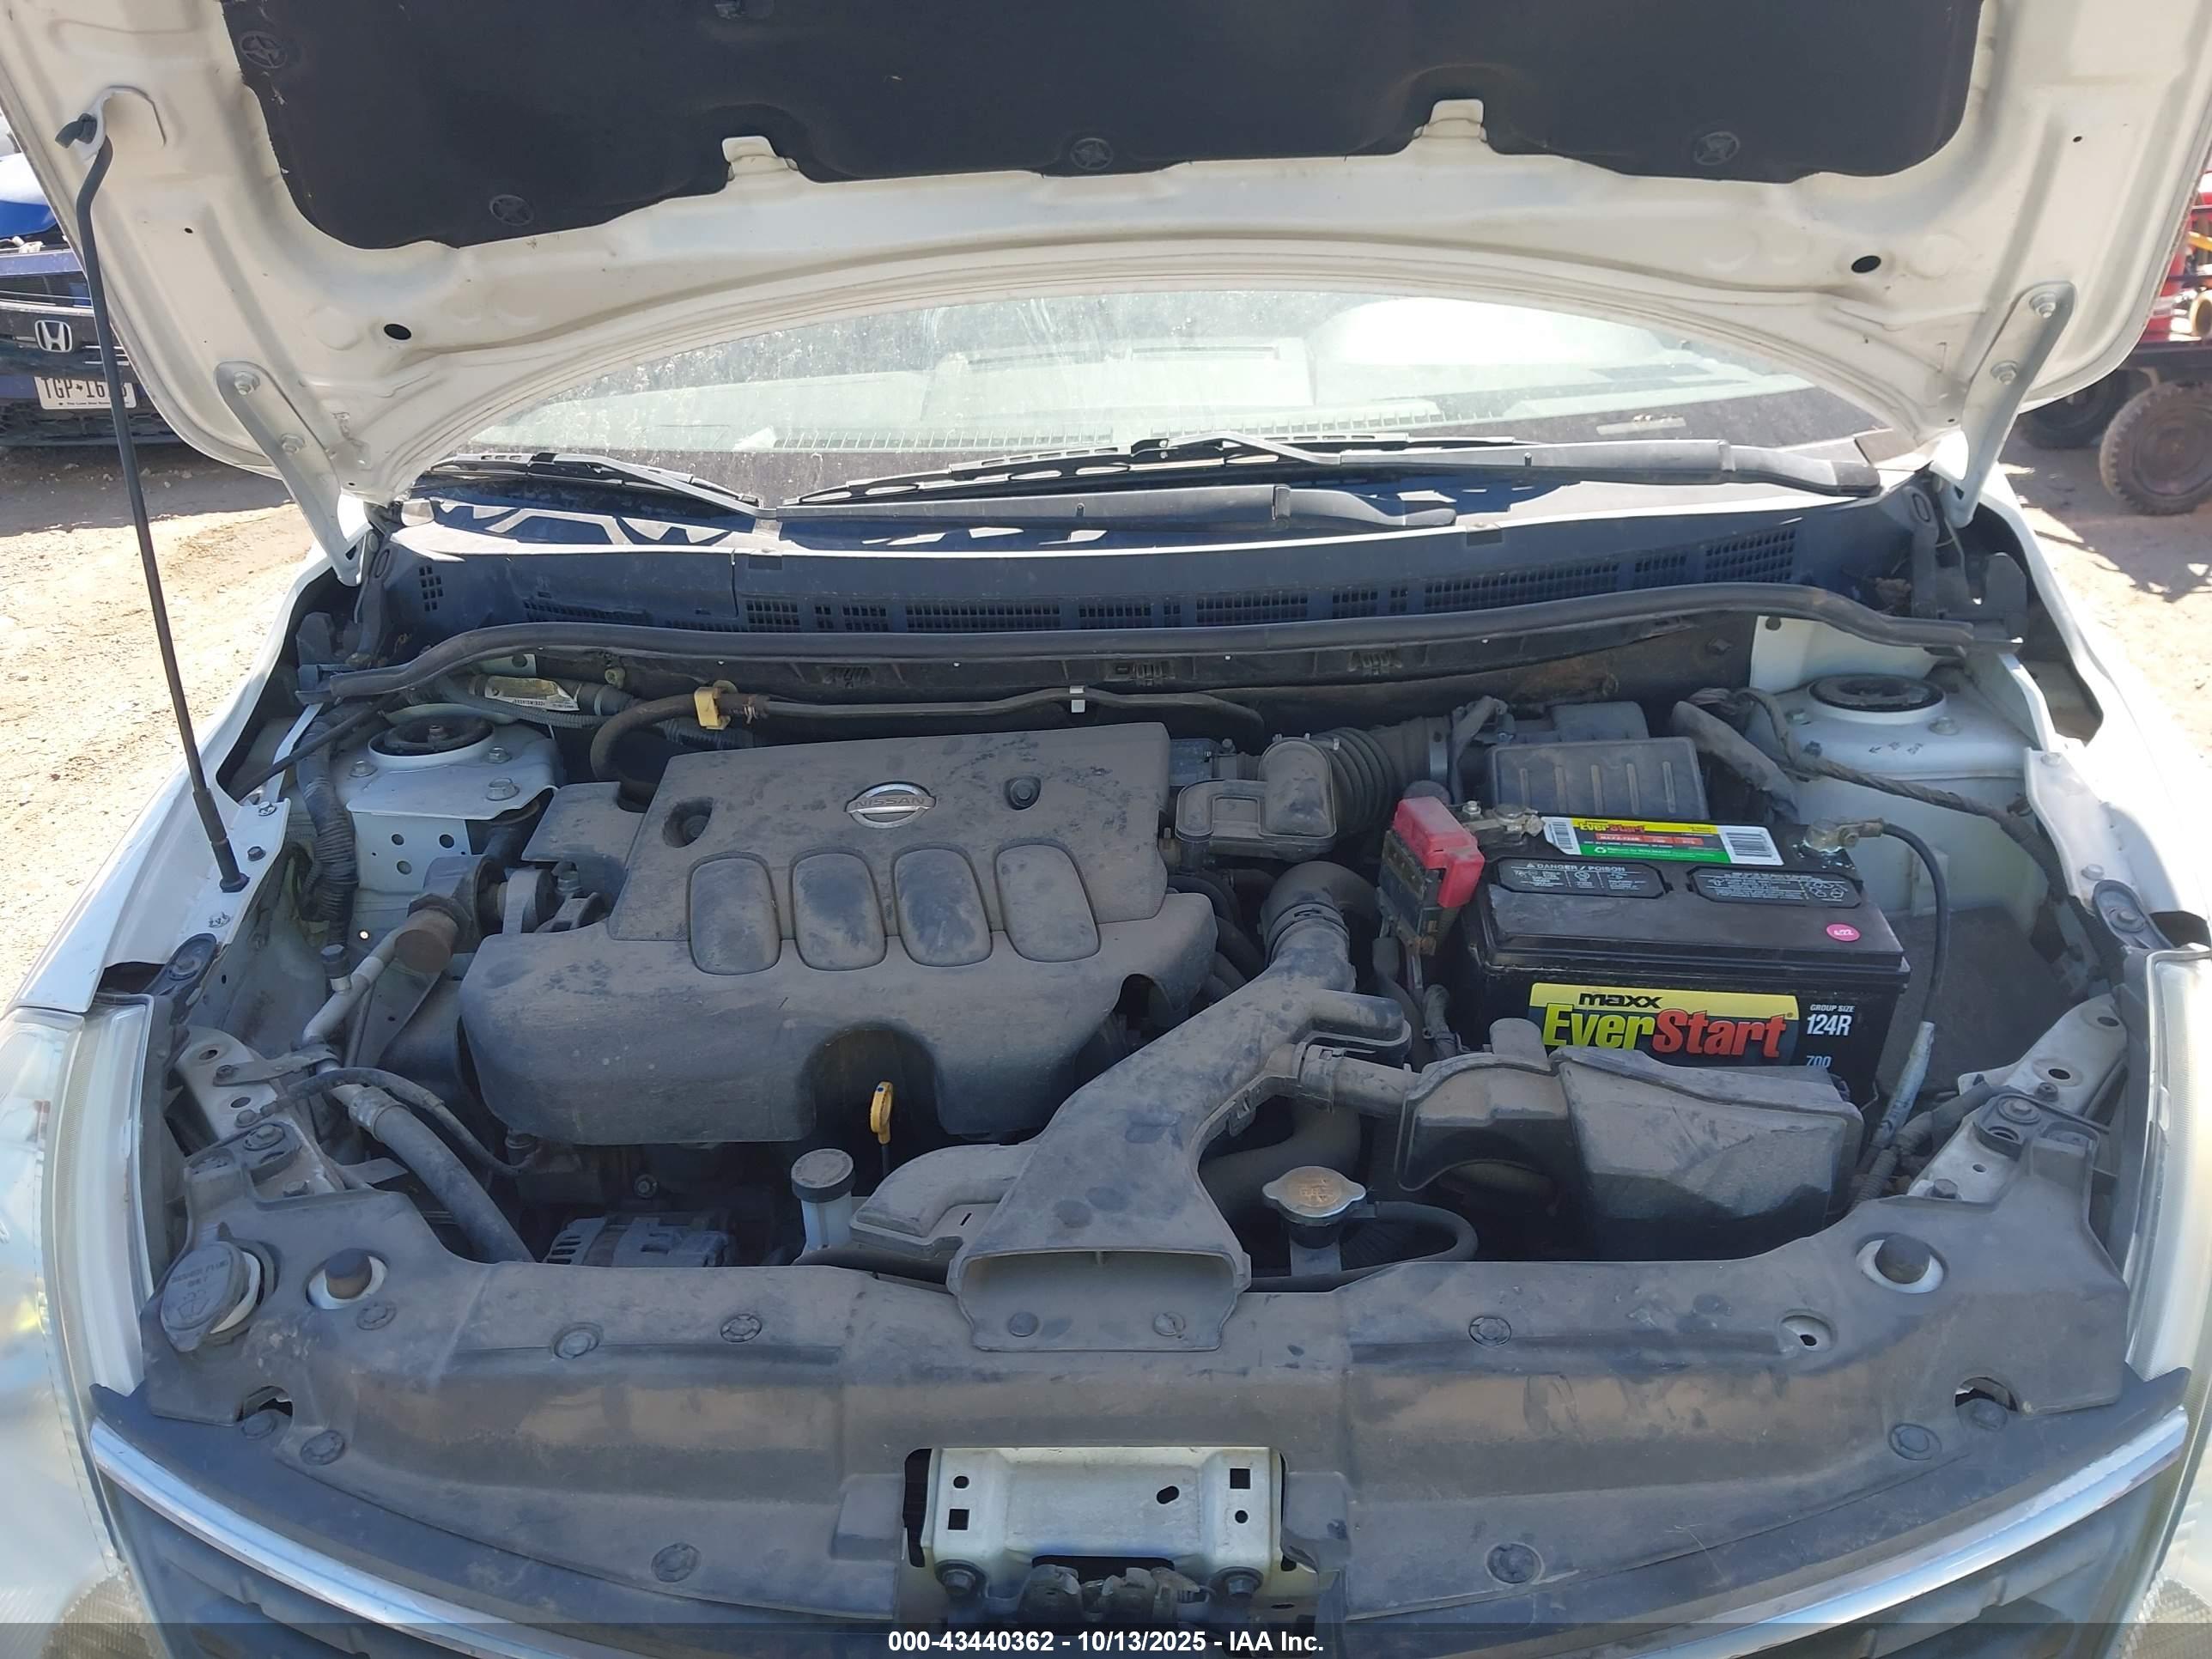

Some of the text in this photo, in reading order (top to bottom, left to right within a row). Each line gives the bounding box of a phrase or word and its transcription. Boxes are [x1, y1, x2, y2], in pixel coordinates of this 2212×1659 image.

[40, 377, 74, 398] TGP
[854, 797, 925, 808] NISSAN
[1578, 822, 1645, 833] EverStart
[1578, 993, 1663, 1009] maxx
[1807, 1013, 1852, 1036] 124R
